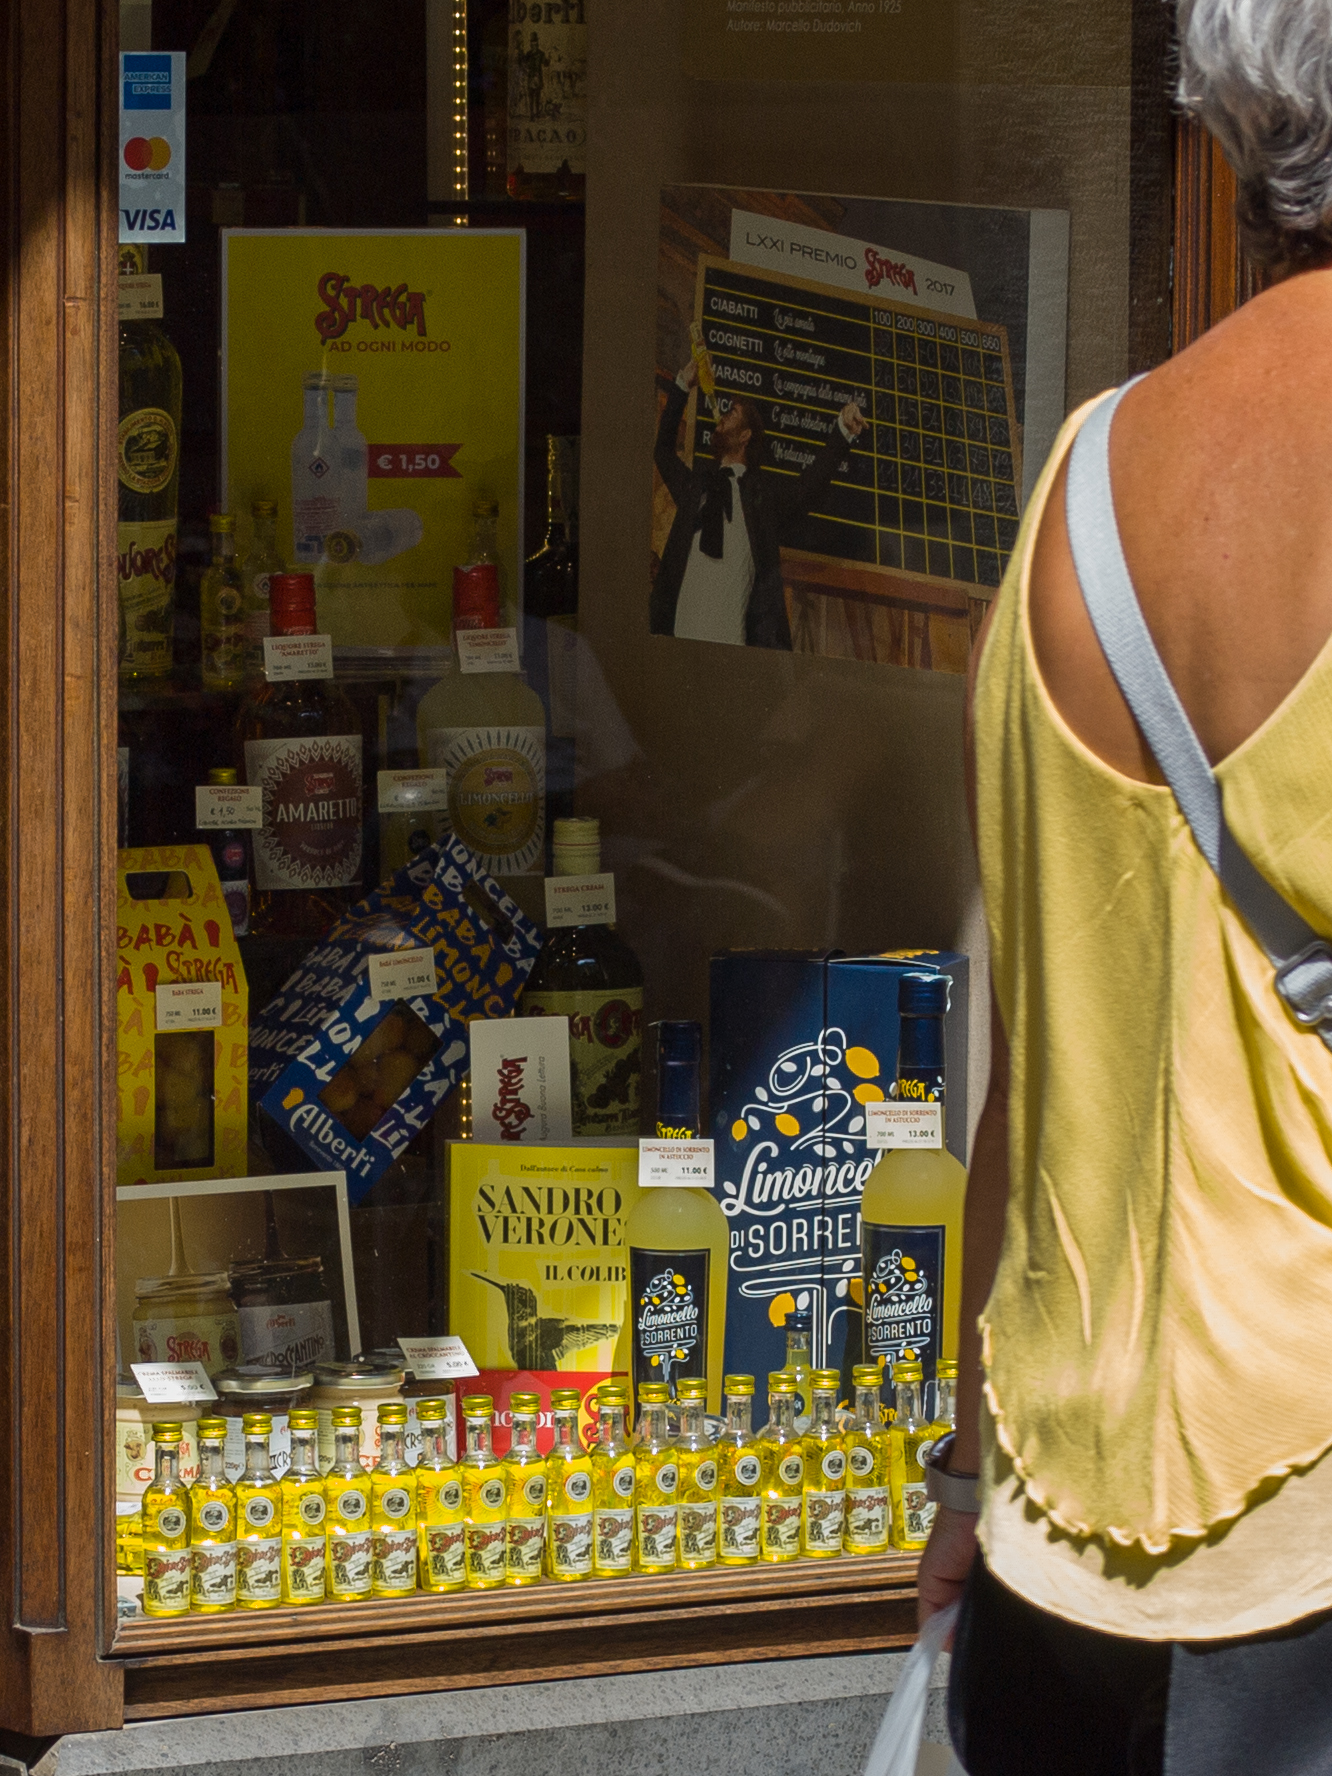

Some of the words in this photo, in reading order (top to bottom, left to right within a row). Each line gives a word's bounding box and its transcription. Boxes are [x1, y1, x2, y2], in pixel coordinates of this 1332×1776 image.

[766, 19, 810, 32] Marcello
[812, 19, 862, 33] Dudovich
[123, 73, 169, 82] AMERICAN
[132, 85, 172, 94] EXPRESS
[124, 172, 169, 180] mastercard
[120, 209, 177, 231] VISA
[745, 231, 785, 254] LXXI
[789, 242, 858, 271] PREMIO
[924, 277, 956, 297] 2017
[709, 296, 759, 320] CIABATTI
[873, 310, 893, 327] 100
[896, 315, 915, 332] 200
[916, 320, 936, 337] 300
[938, 325, 958, 342] 400
[960, 331, 980, 347] 500
[328, 341, 352, 353] AD
[356, 341, 396, 353] OGNI
[400, 341, 451, 353] MODO
[708, 329, 764, 354] COGNETTI
[376, 453, 394, 470] €
[398, 454, 441, 473] 1,50
[459, 792, 534, 807] LIMONCELLO
[276, 797, 358, 824] AMARETTO
[407, 975, 425, 984] 11.00
[191, 1008, 210, 1016] 11.00
[536, 1055, 548, 1083] Lettura
[868, 1109, 902, 1117] LIMONCELLO
[289, 1103, 376, 1178] Alberti
[908, 1130, 929, 1138] 13.00
[681, 1167, 702, 1175] 11.00
[477, 1183, 623, 1218] SANDRO
[477, 1214, 627, 1248] VERONE
[730, 1229, 745, 1249] DI
[545, 1265, 565, 1282] IL
[567, 1265, 627, 1282] COLIB
[637, 1303, 699, 1331] Limoncello
[866, 1293, 934, 1325] Limoncello
[644, 1324, 698, 1345] SORRENTO
[871, 1318, 932, 1342] SORRENTO
